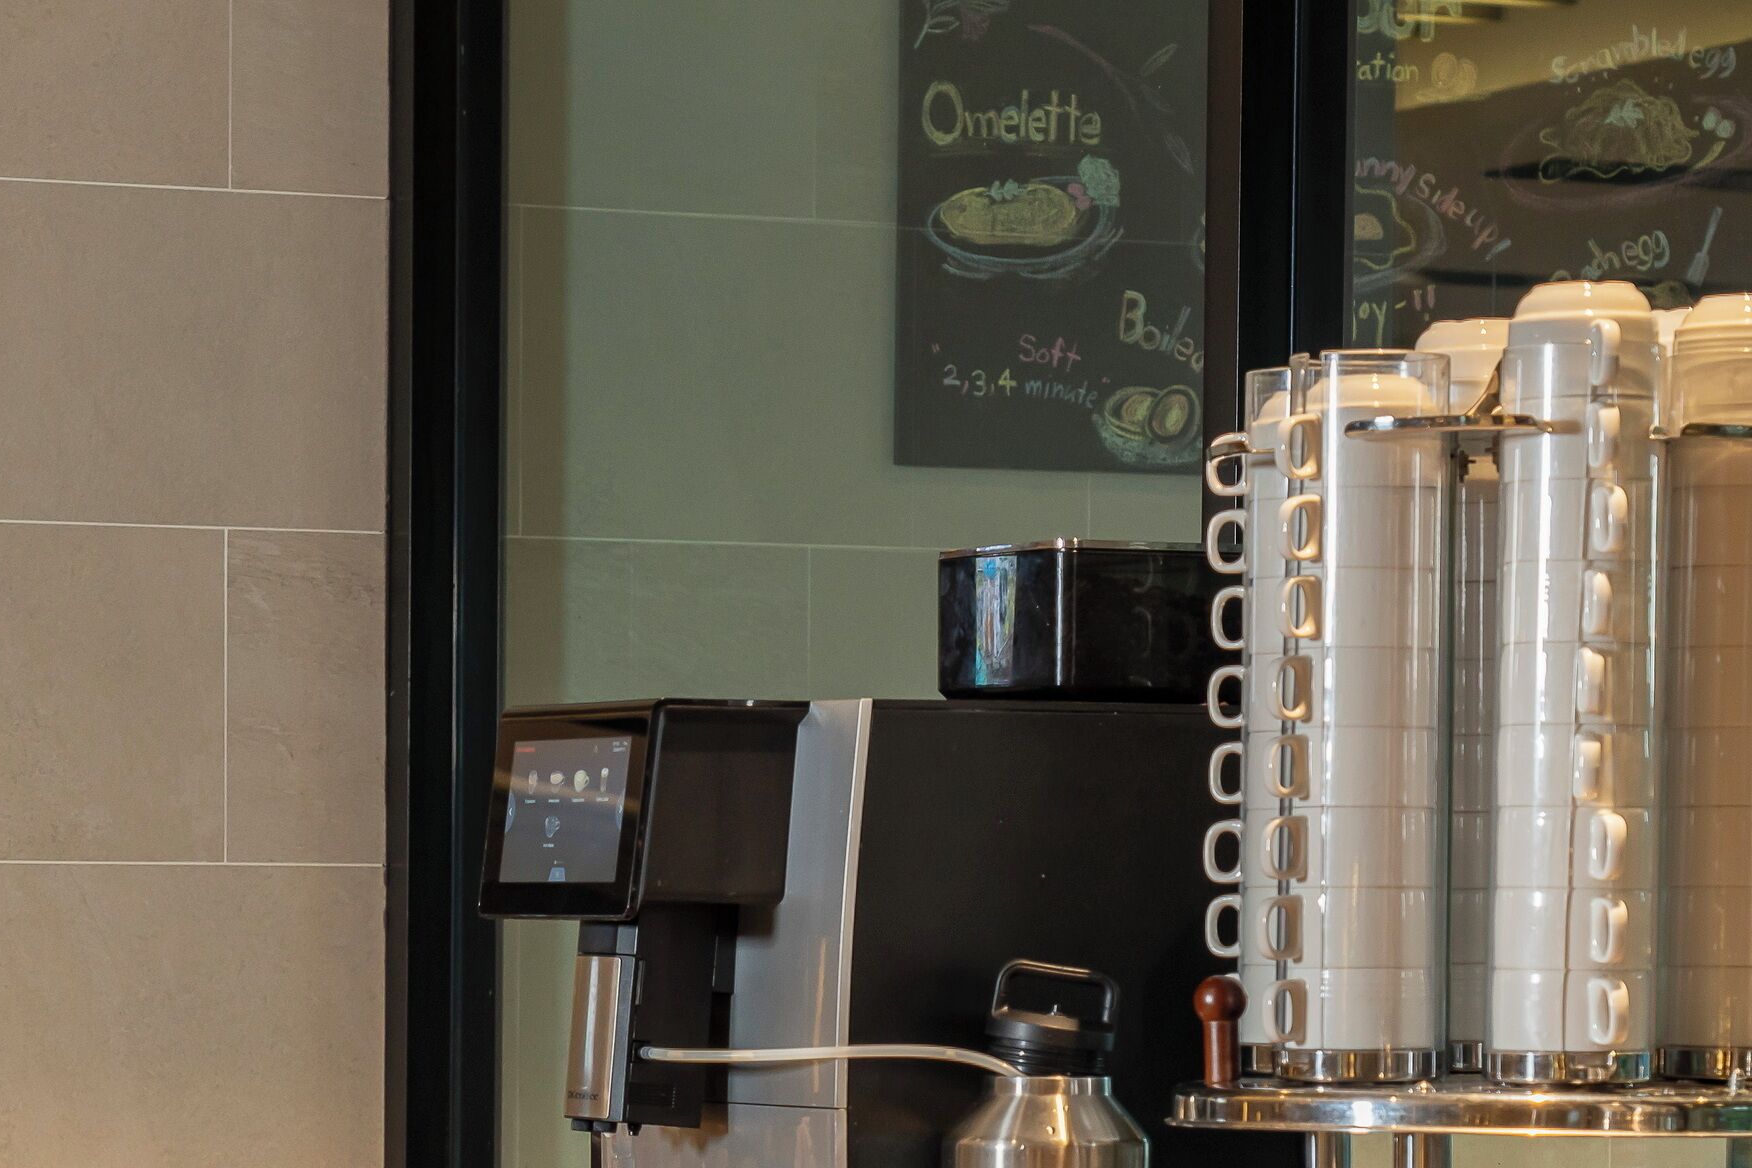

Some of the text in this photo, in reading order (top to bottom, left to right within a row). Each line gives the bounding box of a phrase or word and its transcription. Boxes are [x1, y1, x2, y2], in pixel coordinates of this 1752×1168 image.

[1356, 52, 1420, 83] ation
[1687, 46, 1737, 80] egg
[921, 80, 1102, 146] Omelette
[1019, 335, 1082, 372] Soft
